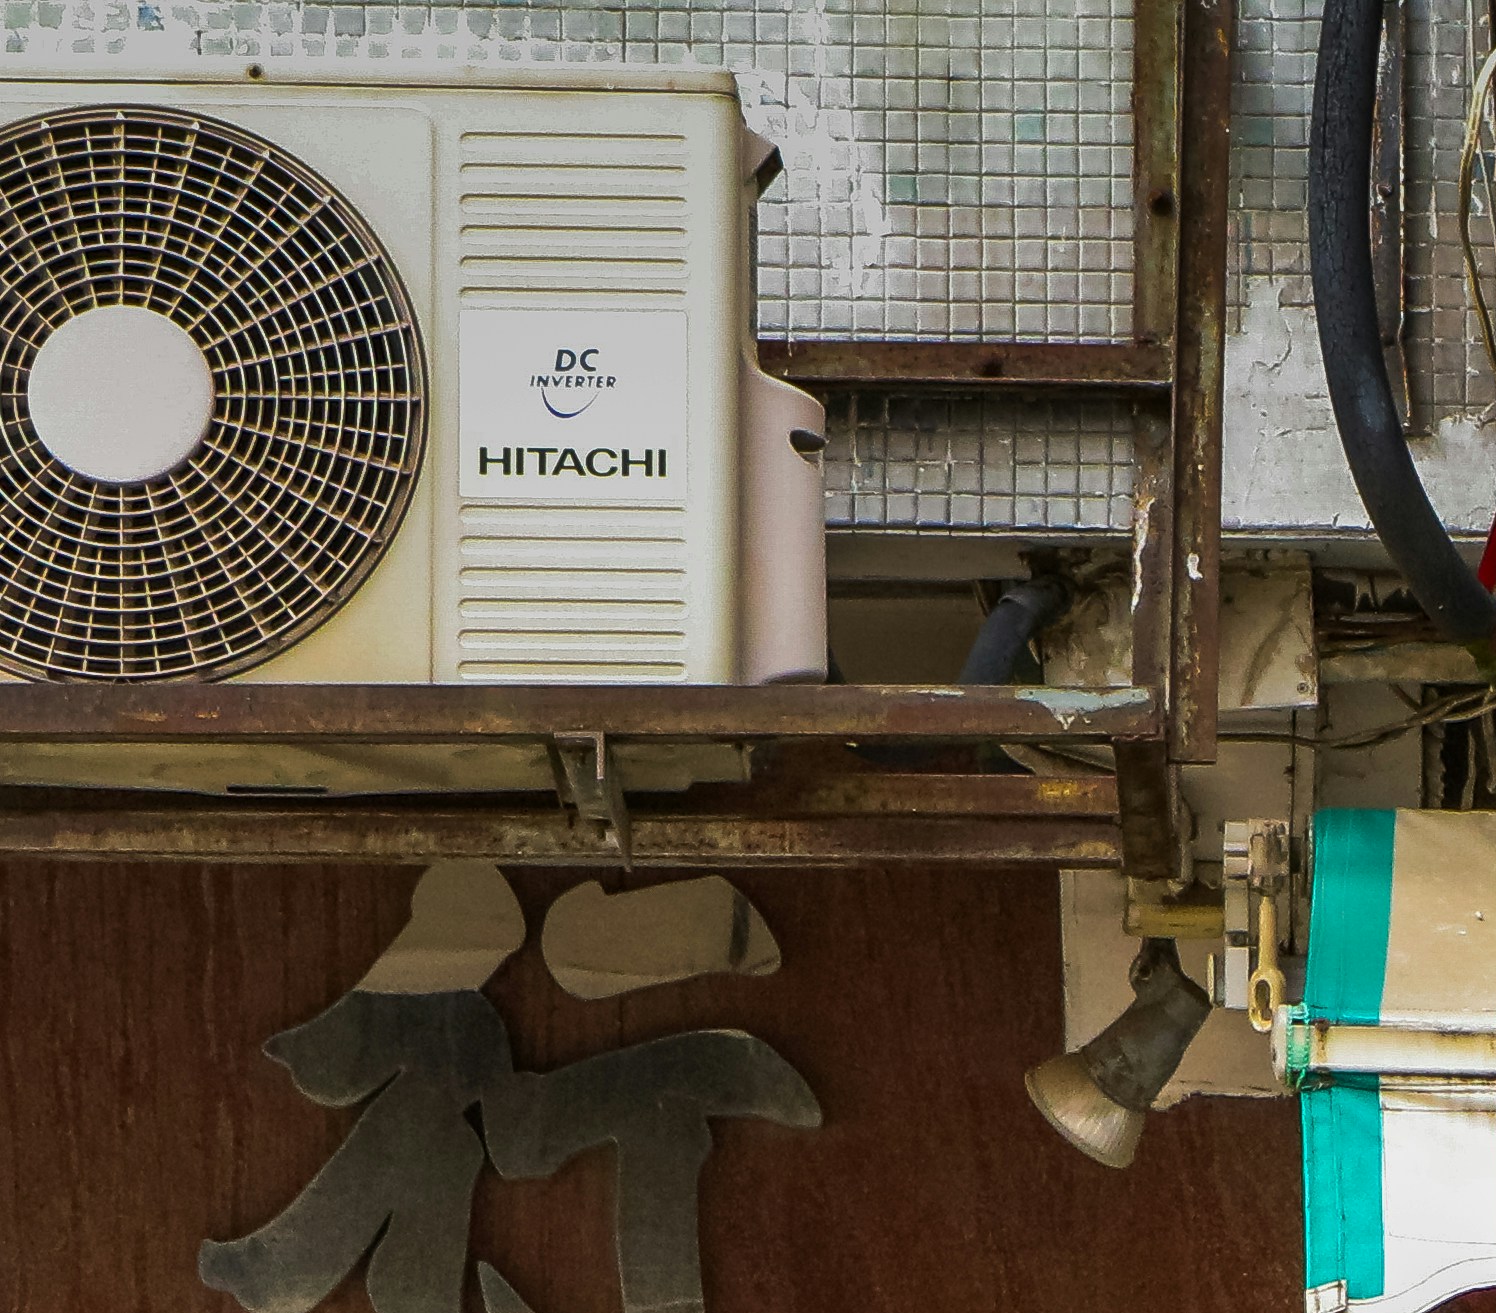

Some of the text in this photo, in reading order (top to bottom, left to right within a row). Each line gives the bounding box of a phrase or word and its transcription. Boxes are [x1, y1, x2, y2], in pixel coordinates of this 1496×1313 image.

[555, 349, 599, 372] DC
[530, 375, 617, 388] INVERTER
[478, 447, 667, 477] HITACHI
